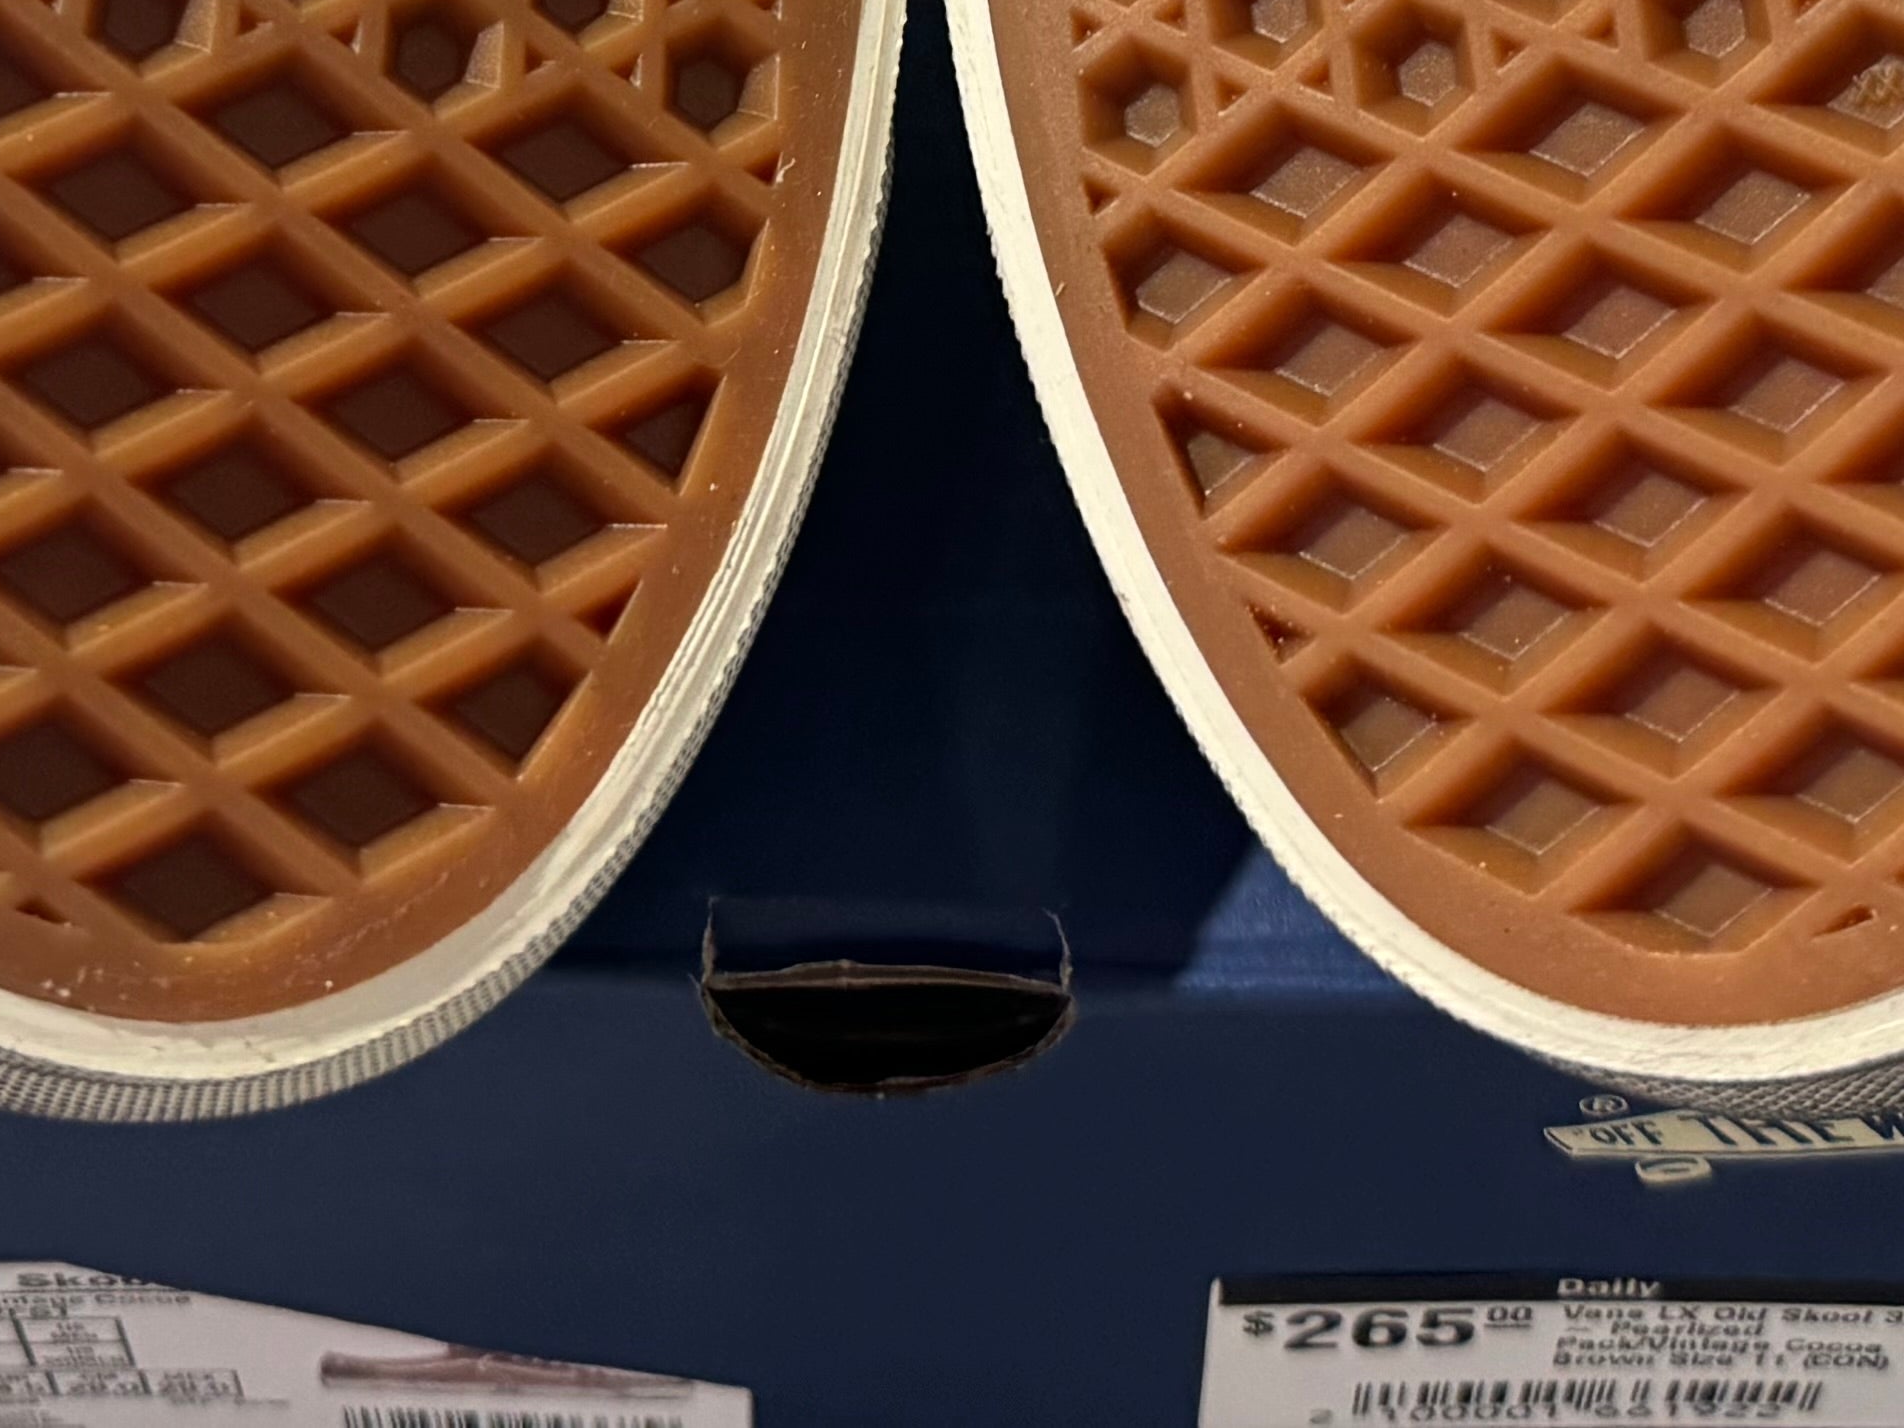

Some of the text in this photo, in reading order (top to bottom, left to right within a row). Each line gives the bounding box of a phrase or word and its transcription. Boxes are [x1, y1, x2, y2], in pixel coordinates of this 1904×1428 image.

[1557, 1278, 1662, 1298] Daily
[1659, 1305, 1700, 1320] LX
[1781, 1308, 1872, 1324] Skool
